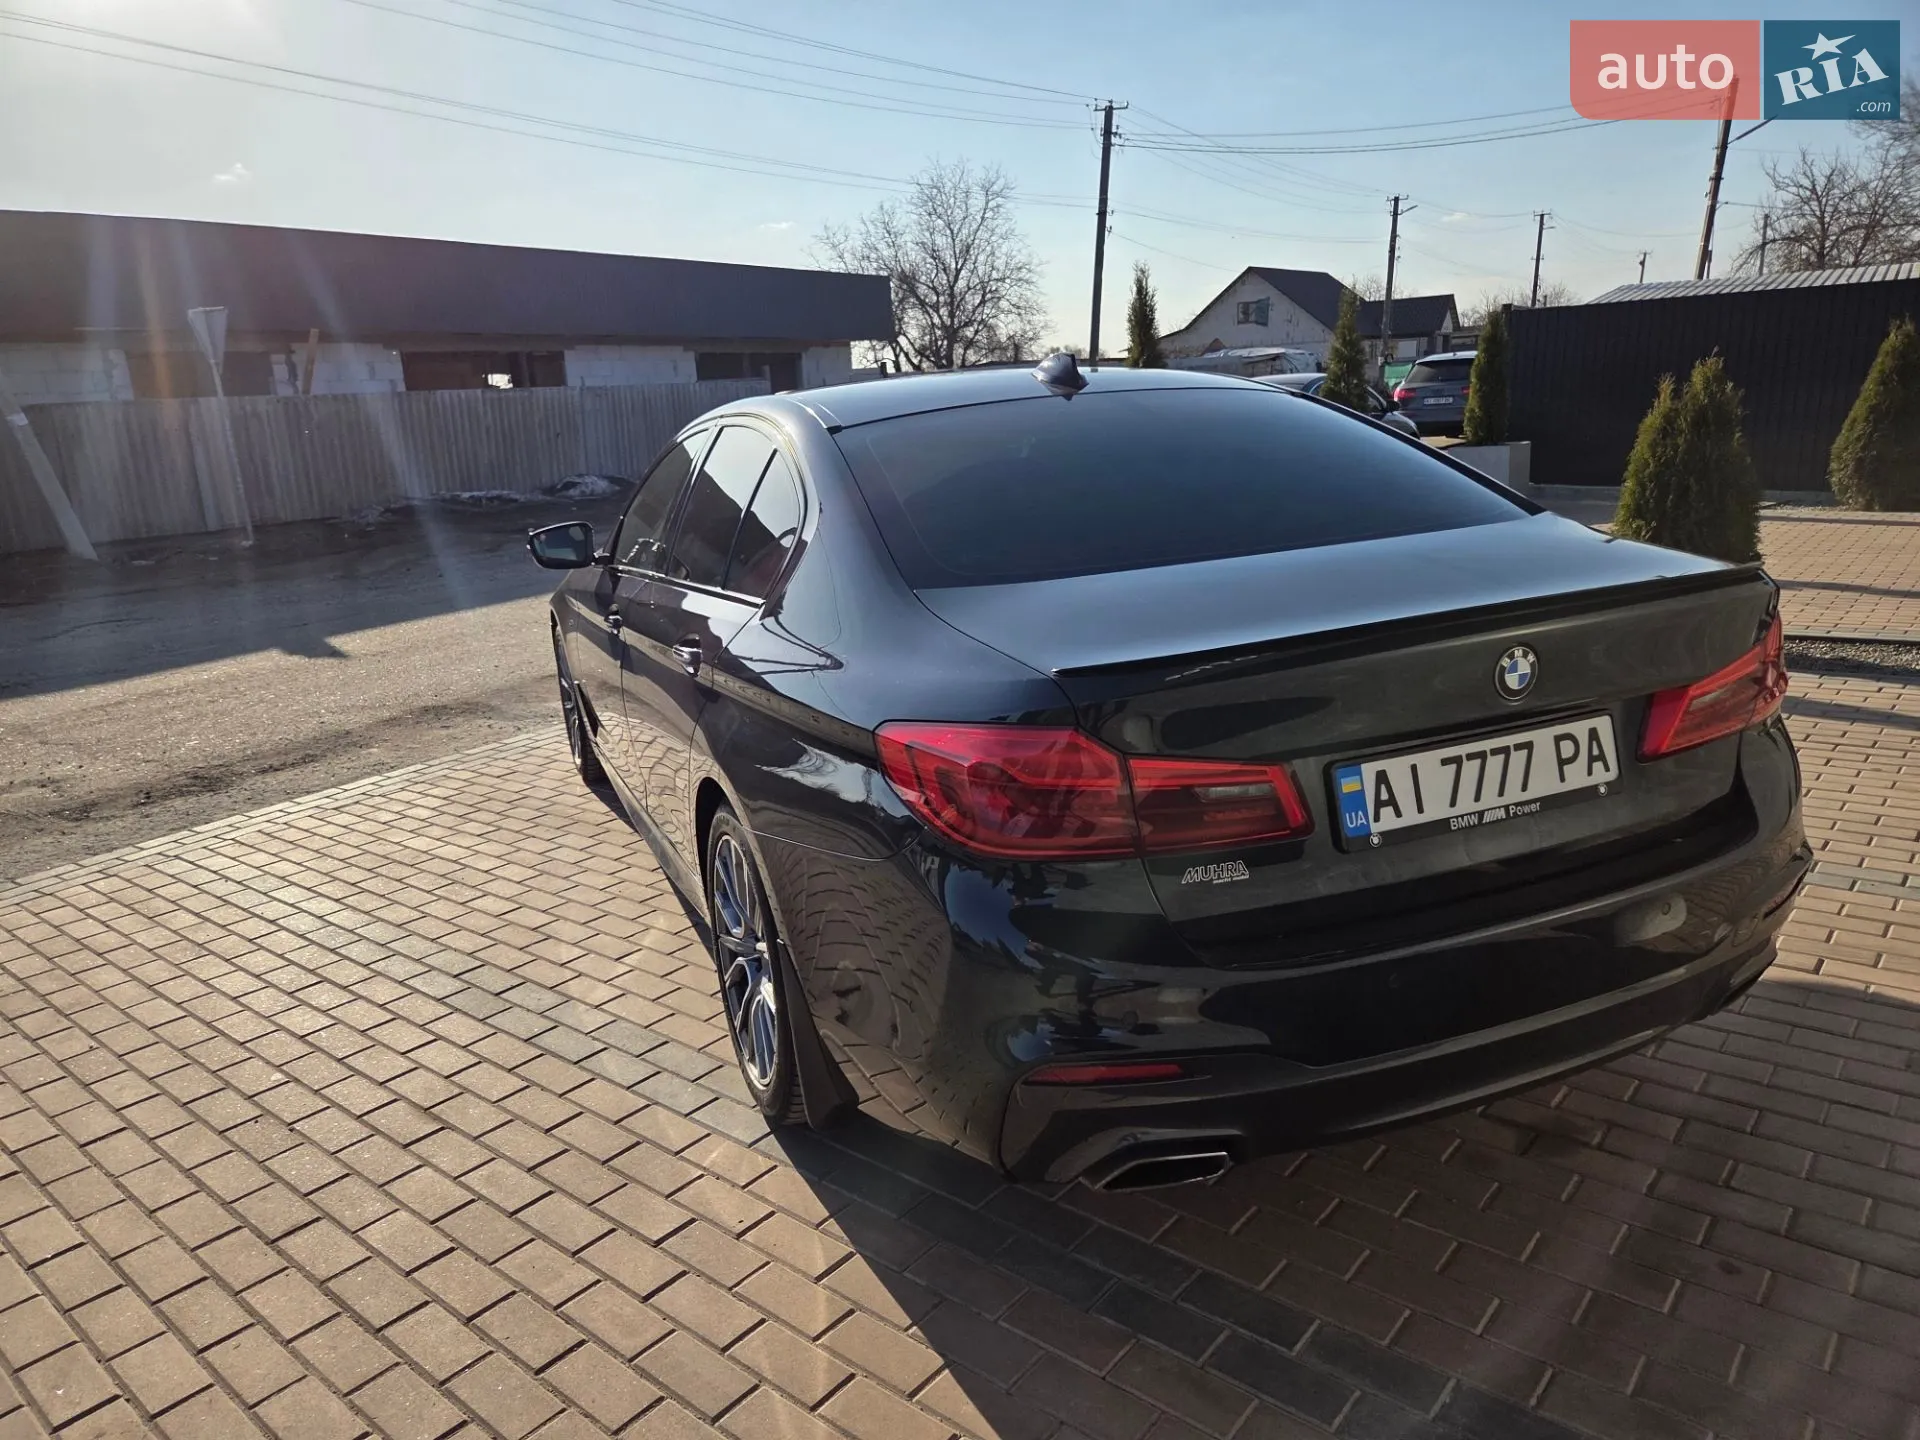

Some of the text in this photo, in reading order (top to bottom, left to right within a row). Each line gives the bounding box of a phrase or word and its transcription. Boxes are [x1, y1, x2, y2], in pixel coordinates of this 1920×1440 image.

[1500, 648, 1536, 668] BMW
[1373, 726, 1611, 823] AI 7777 PA
[1345, 812, 1368, 829] UA
[1449, 813, 1479, 830] BMW
[1508, 802, 1541, 817] Power
[1181, 860, 1250, 884] MUHRA
